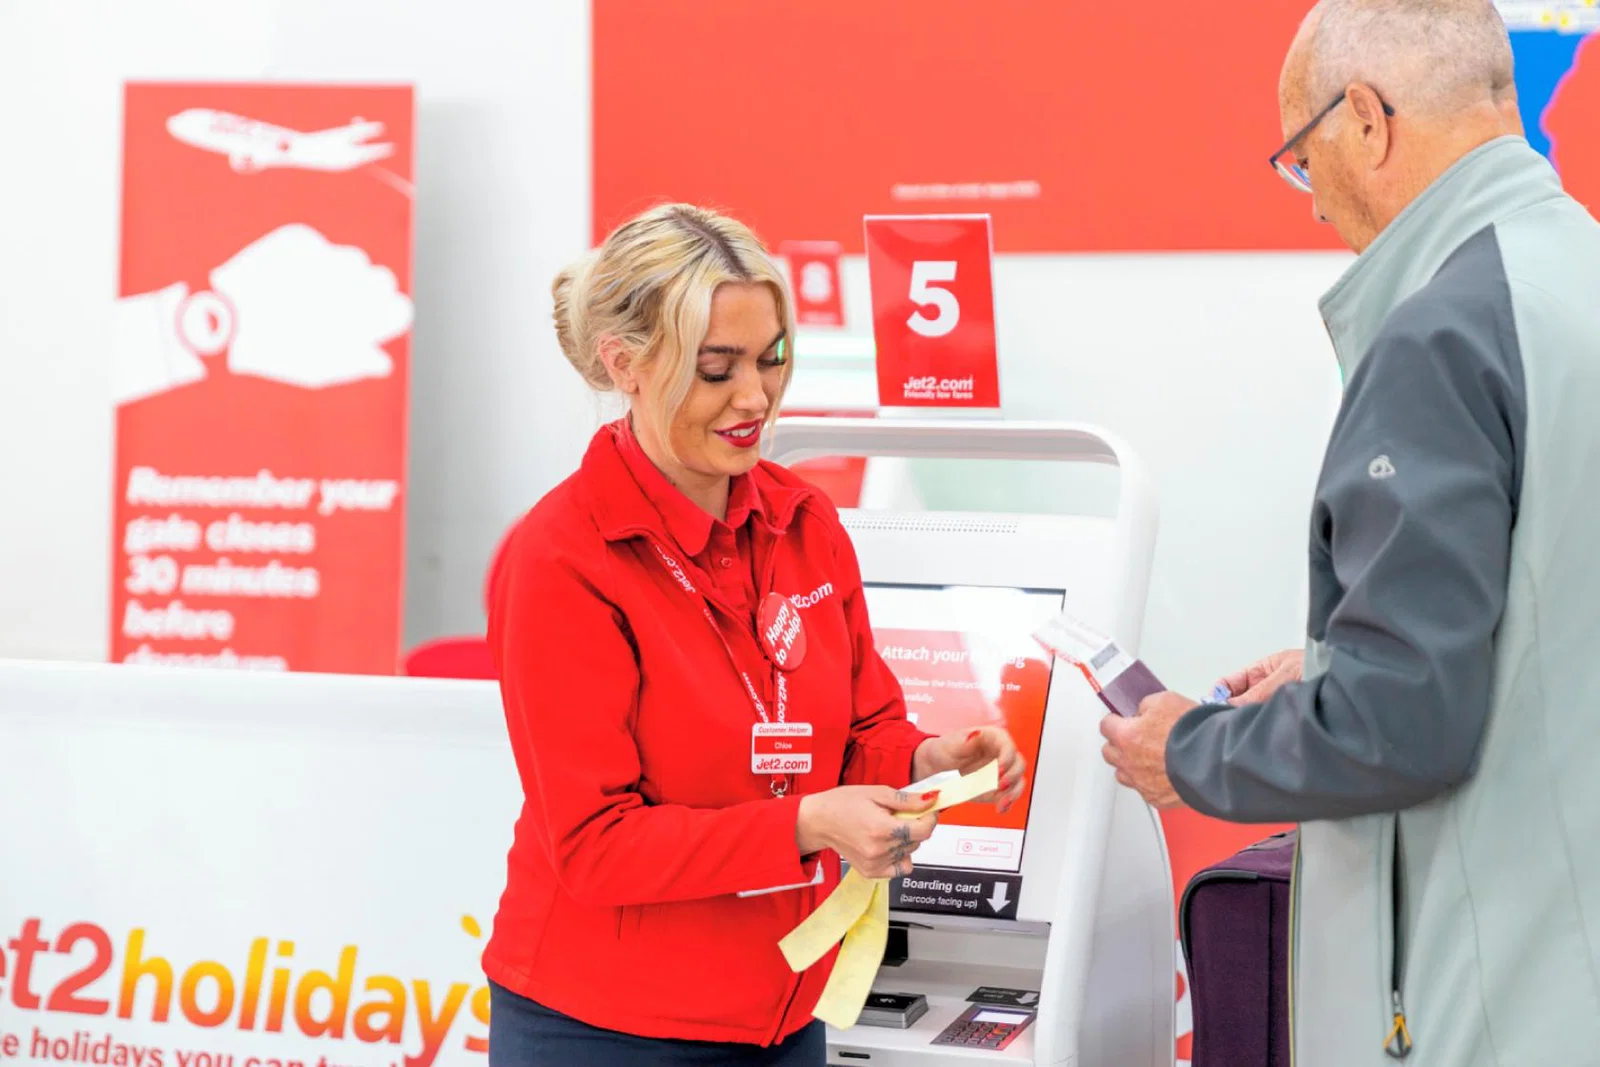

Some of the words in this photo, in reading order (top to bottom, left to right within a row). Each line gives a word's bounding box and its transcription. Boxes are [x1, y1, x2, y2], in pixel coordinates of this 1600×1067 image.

[906, 261, 960, 337] 5
[904, 376, 973, 391] Jet2.com
[128, 466, 315, 508] Remember
[318, 478, 398, 515] your
[206, 512, 315, 553] closes
[125, 555, 178, 595] 30
[180, 557, 319, 597] minutes
[122, 599, 234, 640] before
[766, 601, 790, 647] Happy
[775, 648, 787, 665] to
[782, 608, 801, 651] Help!
[881, 645, 929, 661] Attach
[931, 649, 968, 664] your
[1006, 681, 1021, 691] the
[756, 758, 808, 770] Jet2.com
[774, 741, 792, 749] Chloe
[900, 894, 936, 905] (barcode
[938, 896, 962, 908] facing
[964, 899, 978, 909] up)
[902, 878, 953, 893] Boarding
[955, 883, 981, 893] card
[30, 1026, 163, 1067] holidays
